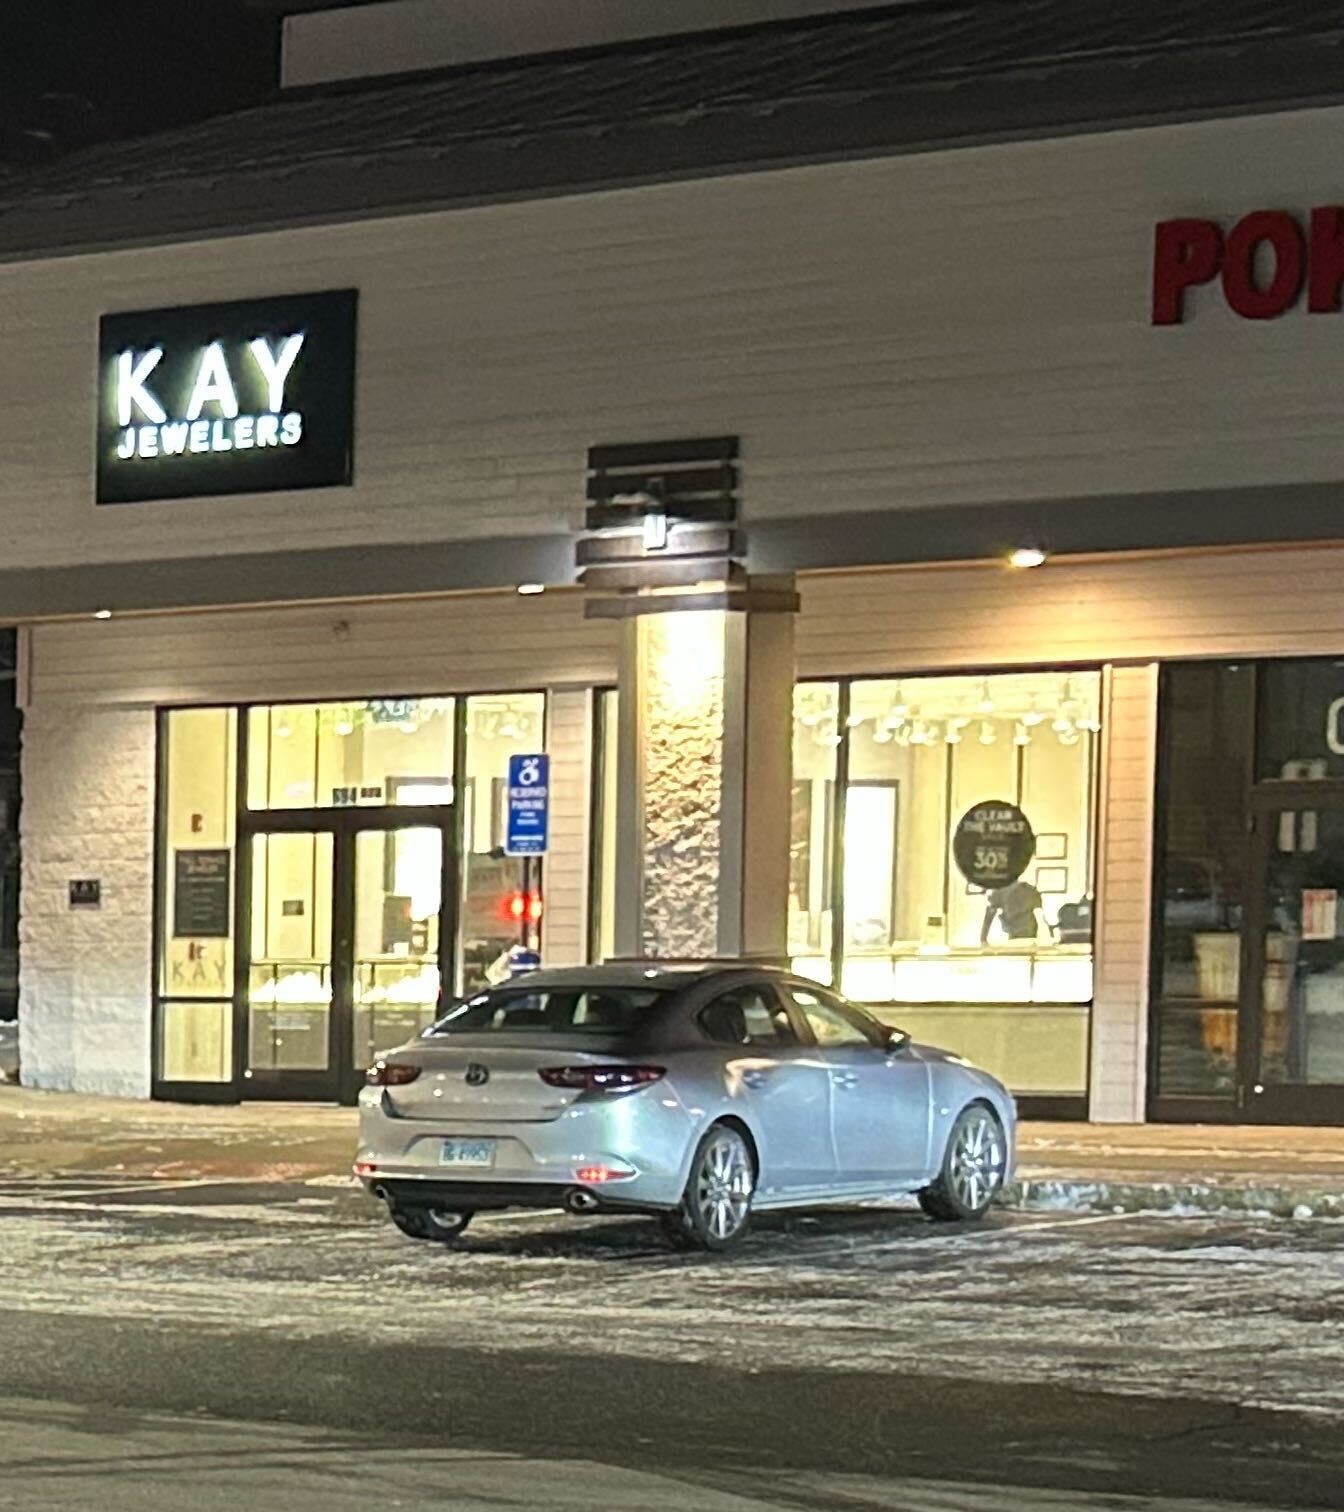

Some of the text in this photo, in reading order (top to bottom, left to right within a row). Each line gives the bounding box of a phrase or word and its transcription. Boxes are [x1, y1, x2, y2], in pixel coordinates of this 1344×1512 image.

[116, 330, 305, 427] KAY
[115, 412, 303, 460] JEWELERS
[171, 961, 227, 983] KAY
